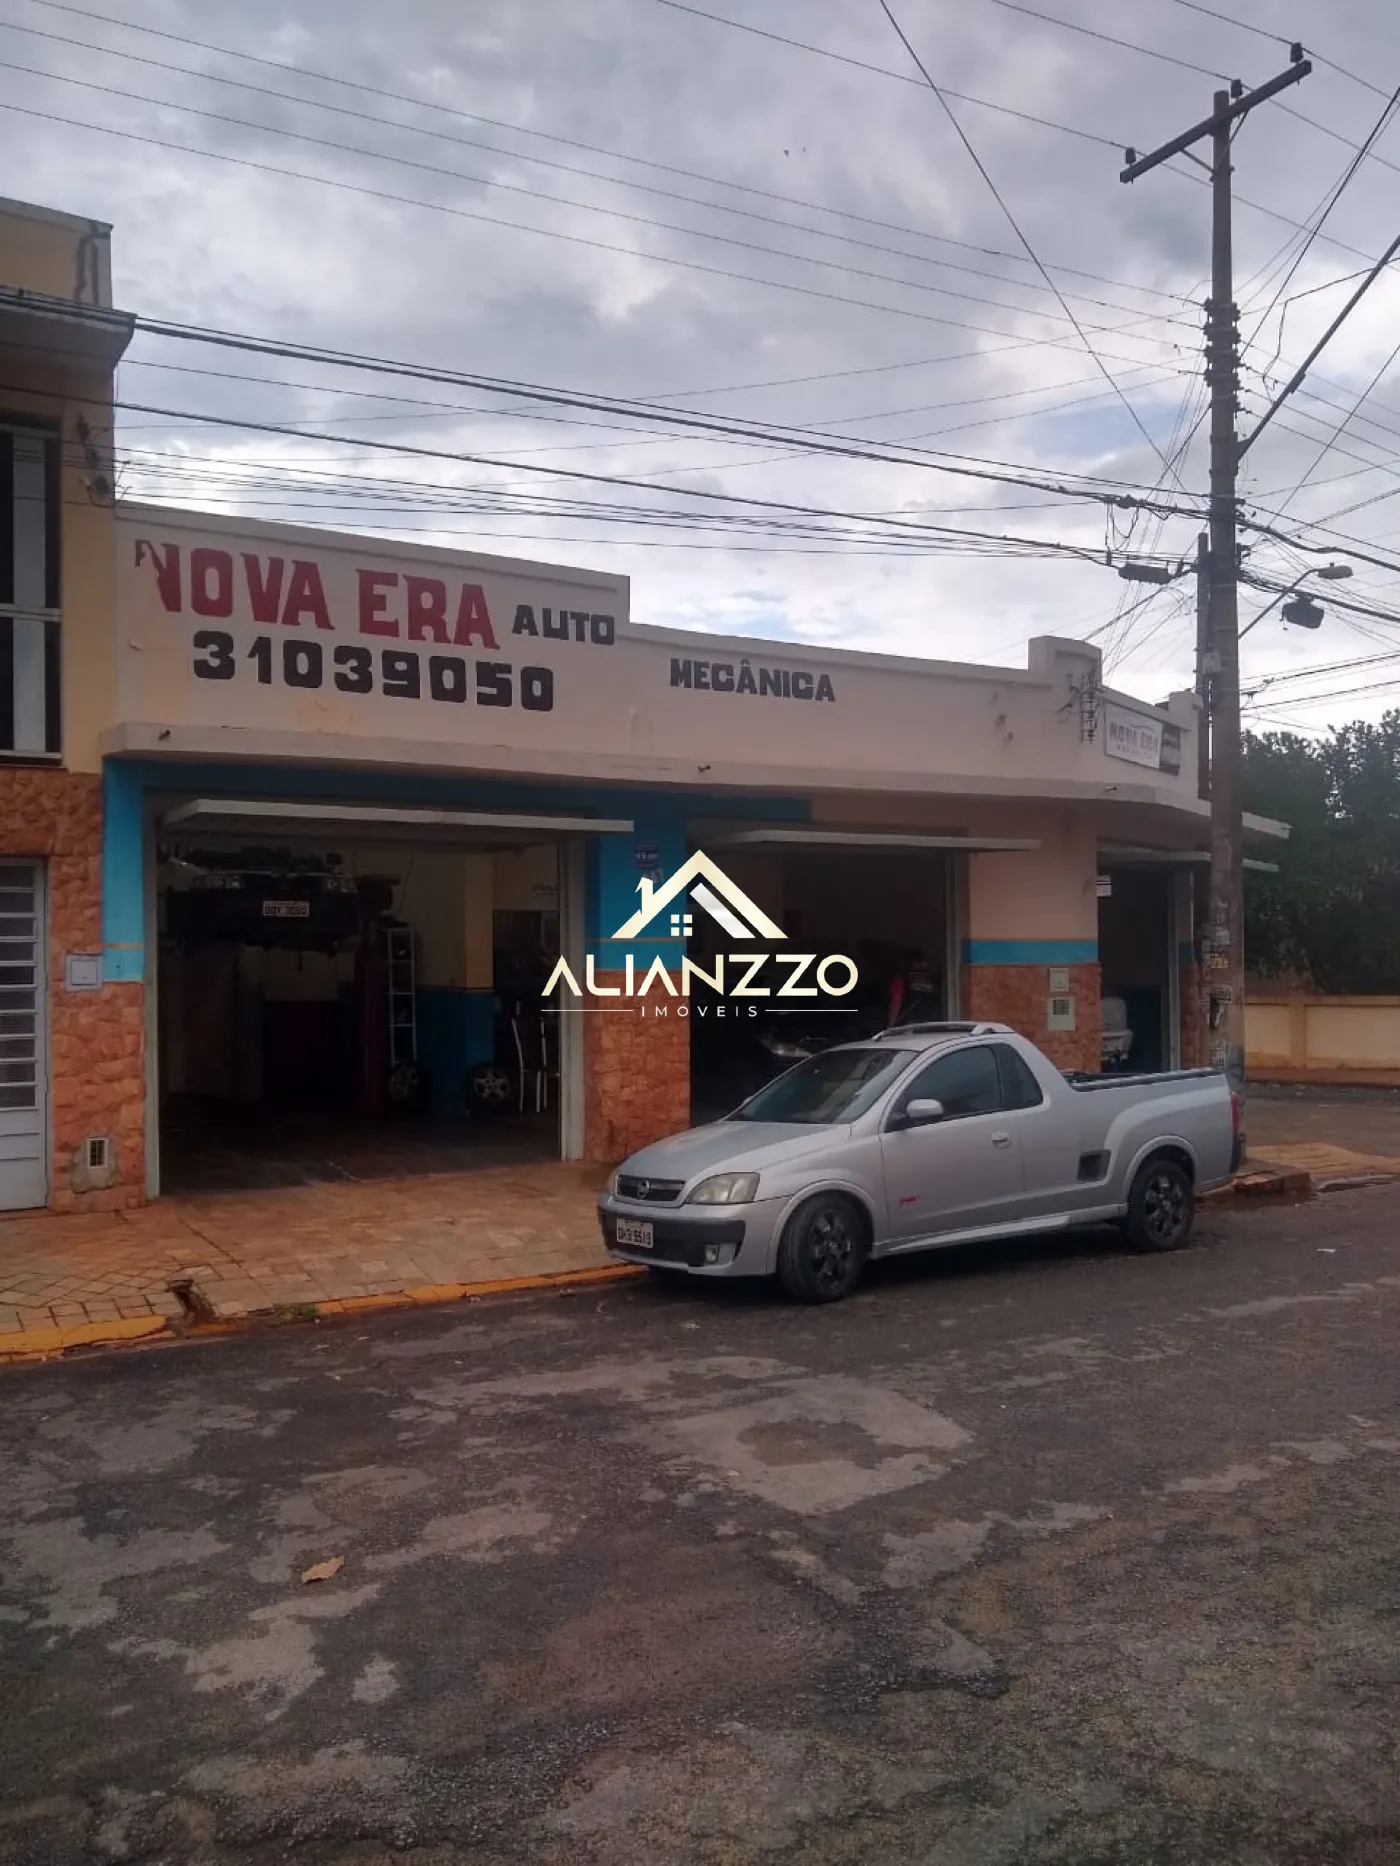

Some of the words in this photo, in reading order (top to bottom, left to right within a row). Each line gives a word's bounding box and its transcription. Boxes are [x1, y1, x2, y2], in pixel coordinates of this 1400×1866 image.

[134, 539, 335, 631] NOVA
[355, 568, 500, 650] ERA
[193, 630, 554, 712] 31039050
[512, 604, 615, 645] AUTO
[670, 658, 836, 702] MECÂNICA
